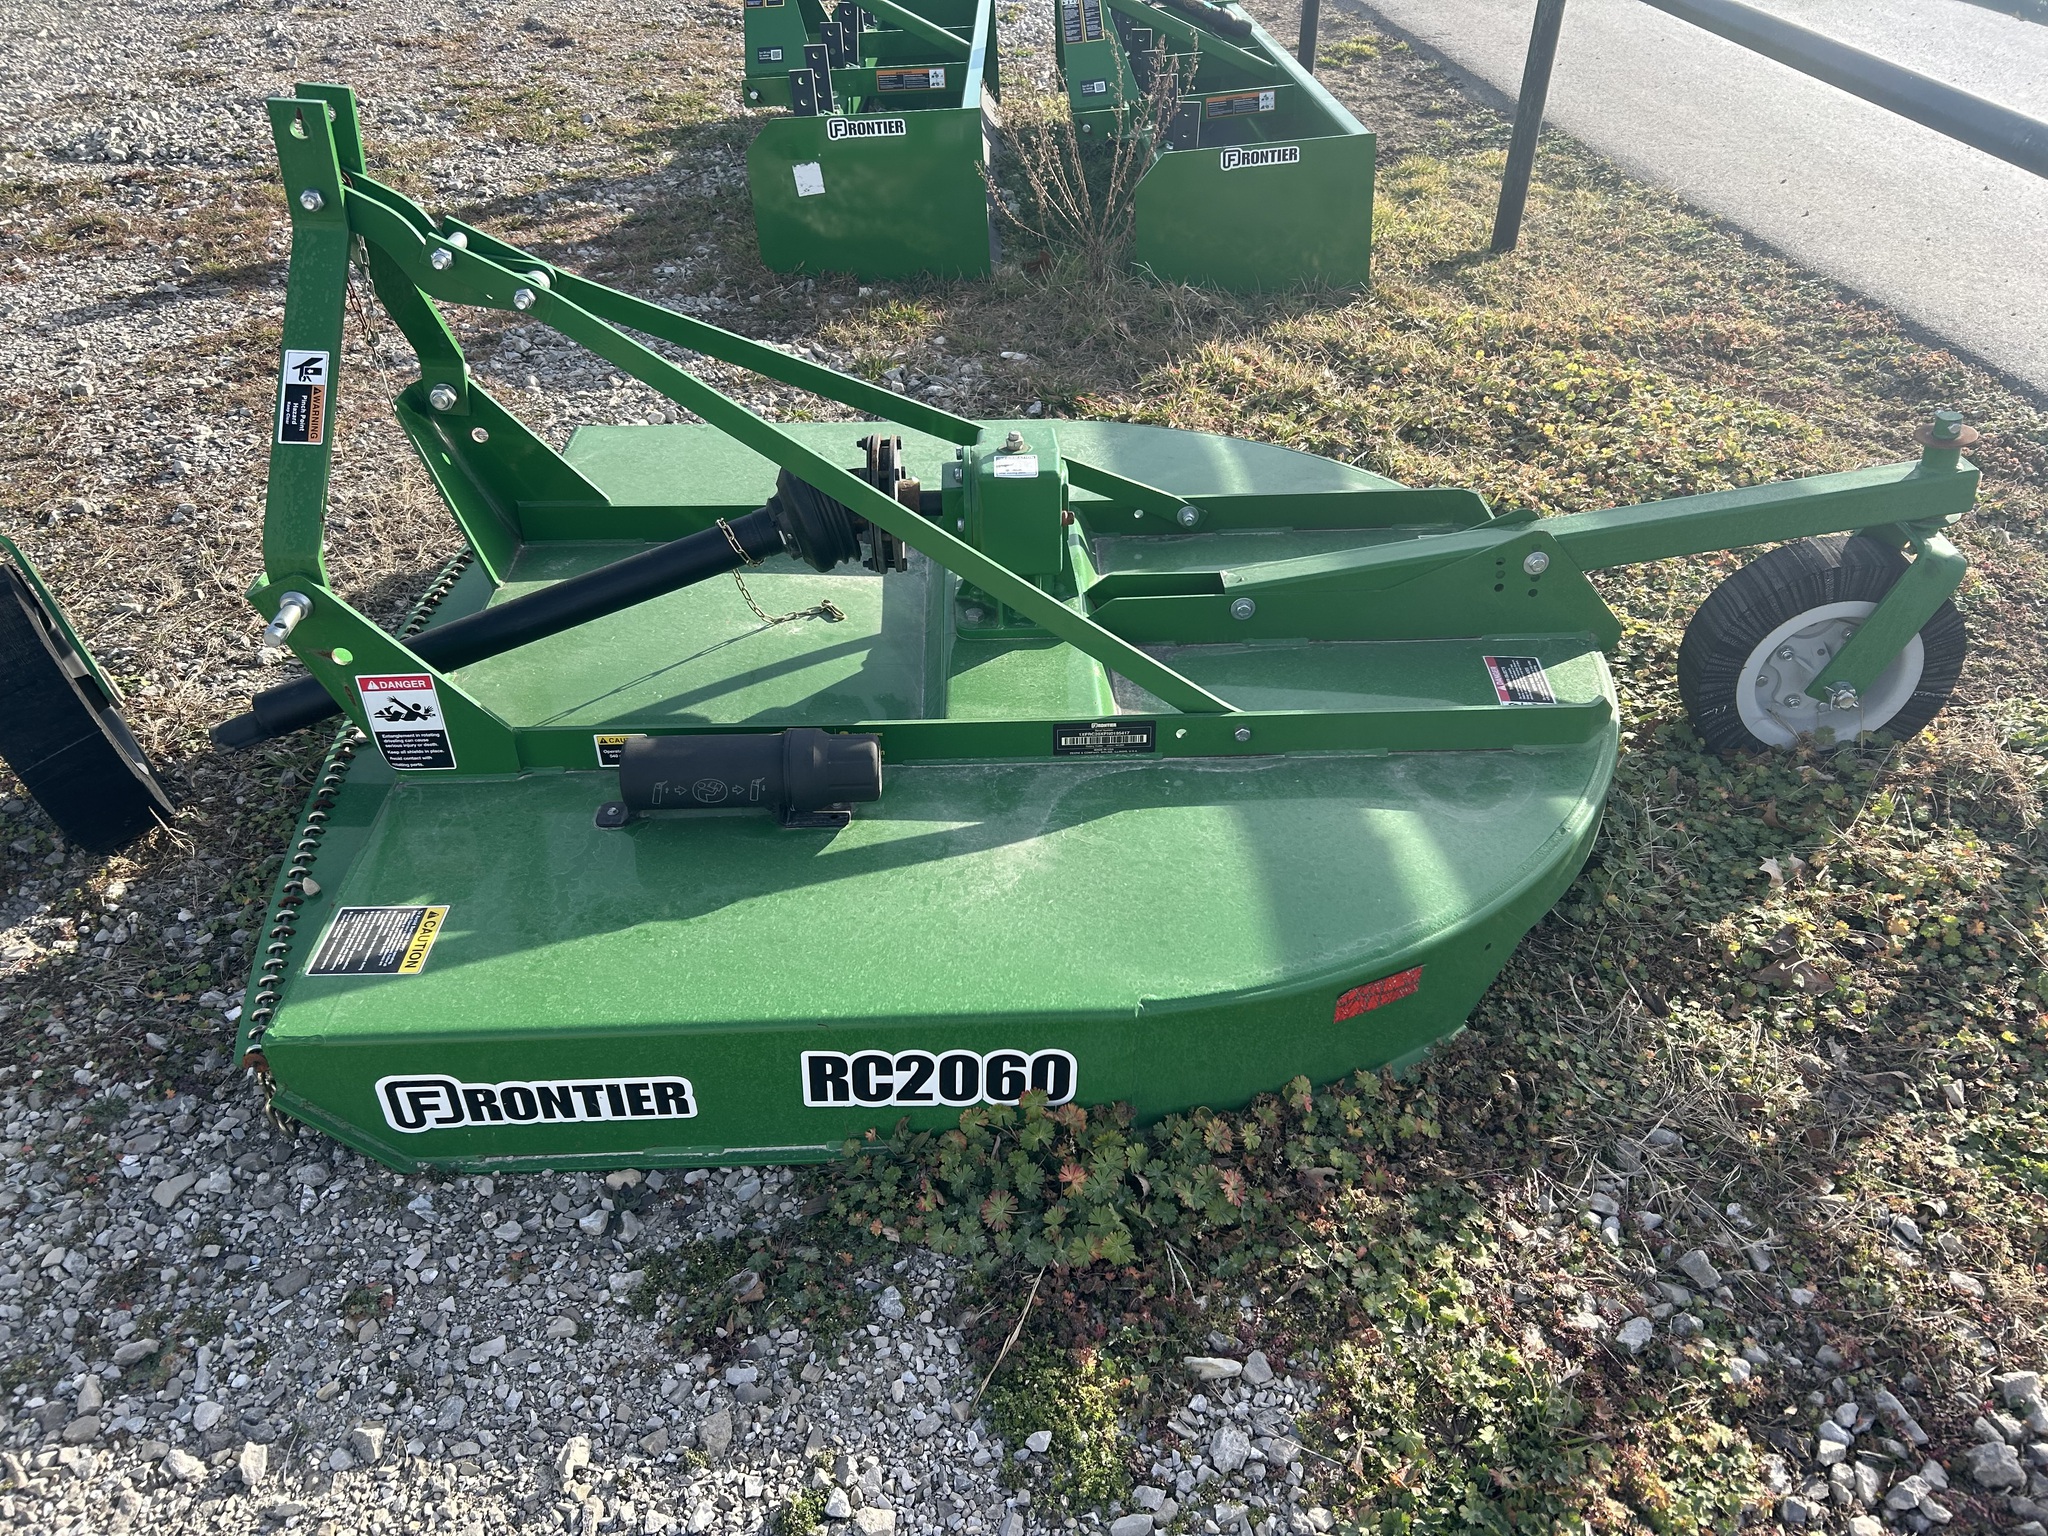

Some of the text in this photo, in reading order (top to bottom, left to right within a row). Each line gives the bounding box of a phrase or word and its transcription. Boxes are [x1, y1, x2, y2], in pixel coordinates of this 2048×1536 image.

[829, 119, 904, 139] FRONTIER
[1223, 147, 1298, 169] FRONTIER
[291, 402, 299, 425] Hazard
[310, 396, 321, 439] WARNING
[379, 680, 426, 689] DANGER
[404, 920, 437, 968] CAUTION
[807, 1054, 1071, 1102] RC2060
[384, 1080, 690, 1129] FRONTIER
